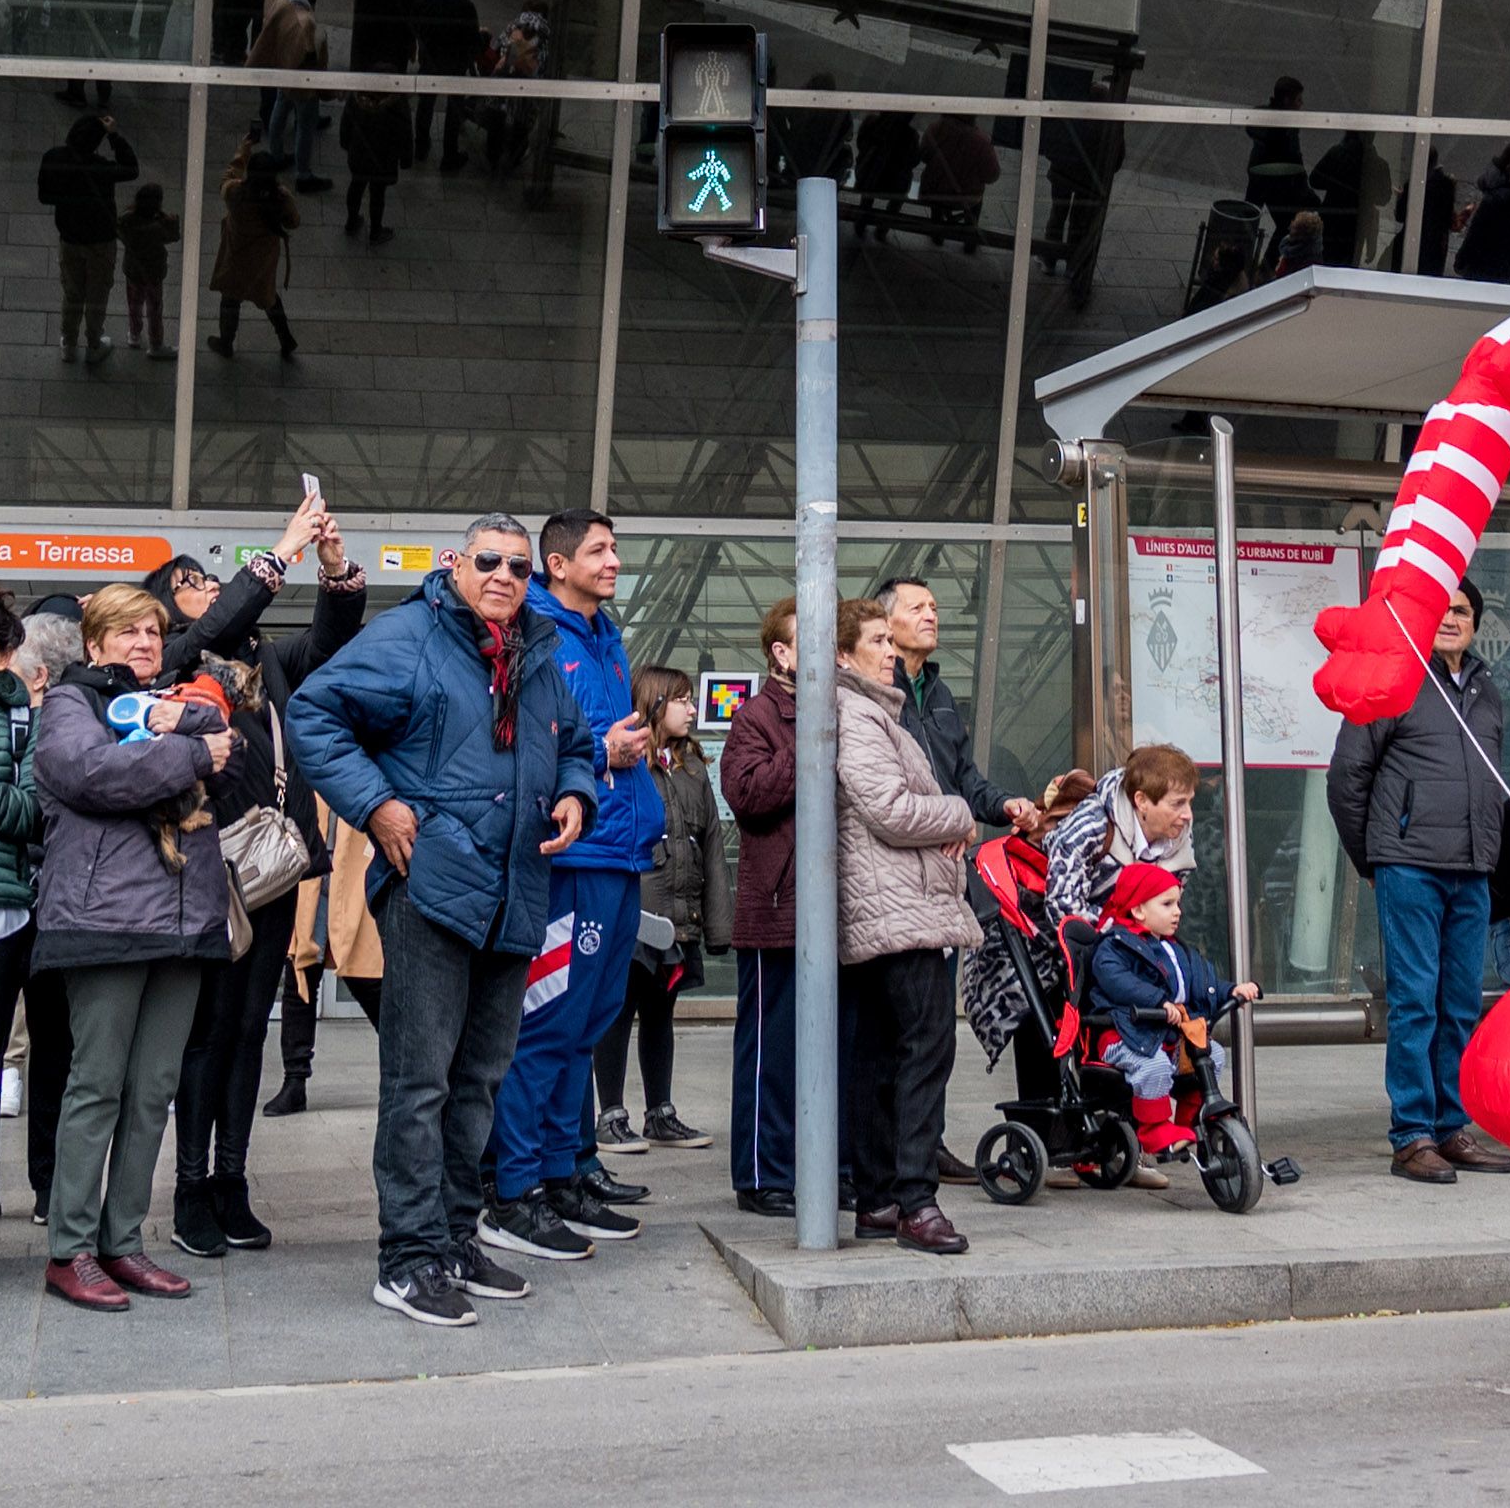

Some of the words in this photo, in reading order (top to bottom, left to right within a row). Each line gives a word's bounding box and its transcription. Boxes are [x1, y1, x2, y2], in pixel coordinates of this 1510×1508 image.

[35, 540, 135, 564] Terrassa
[1146, 540, 1175, 554] LÍNIES
[1247, 547, 1286, 560] URBANS
[1287, 549, 1300, 560] DE
[1301, 548, 1324, 562] RUBÍ
